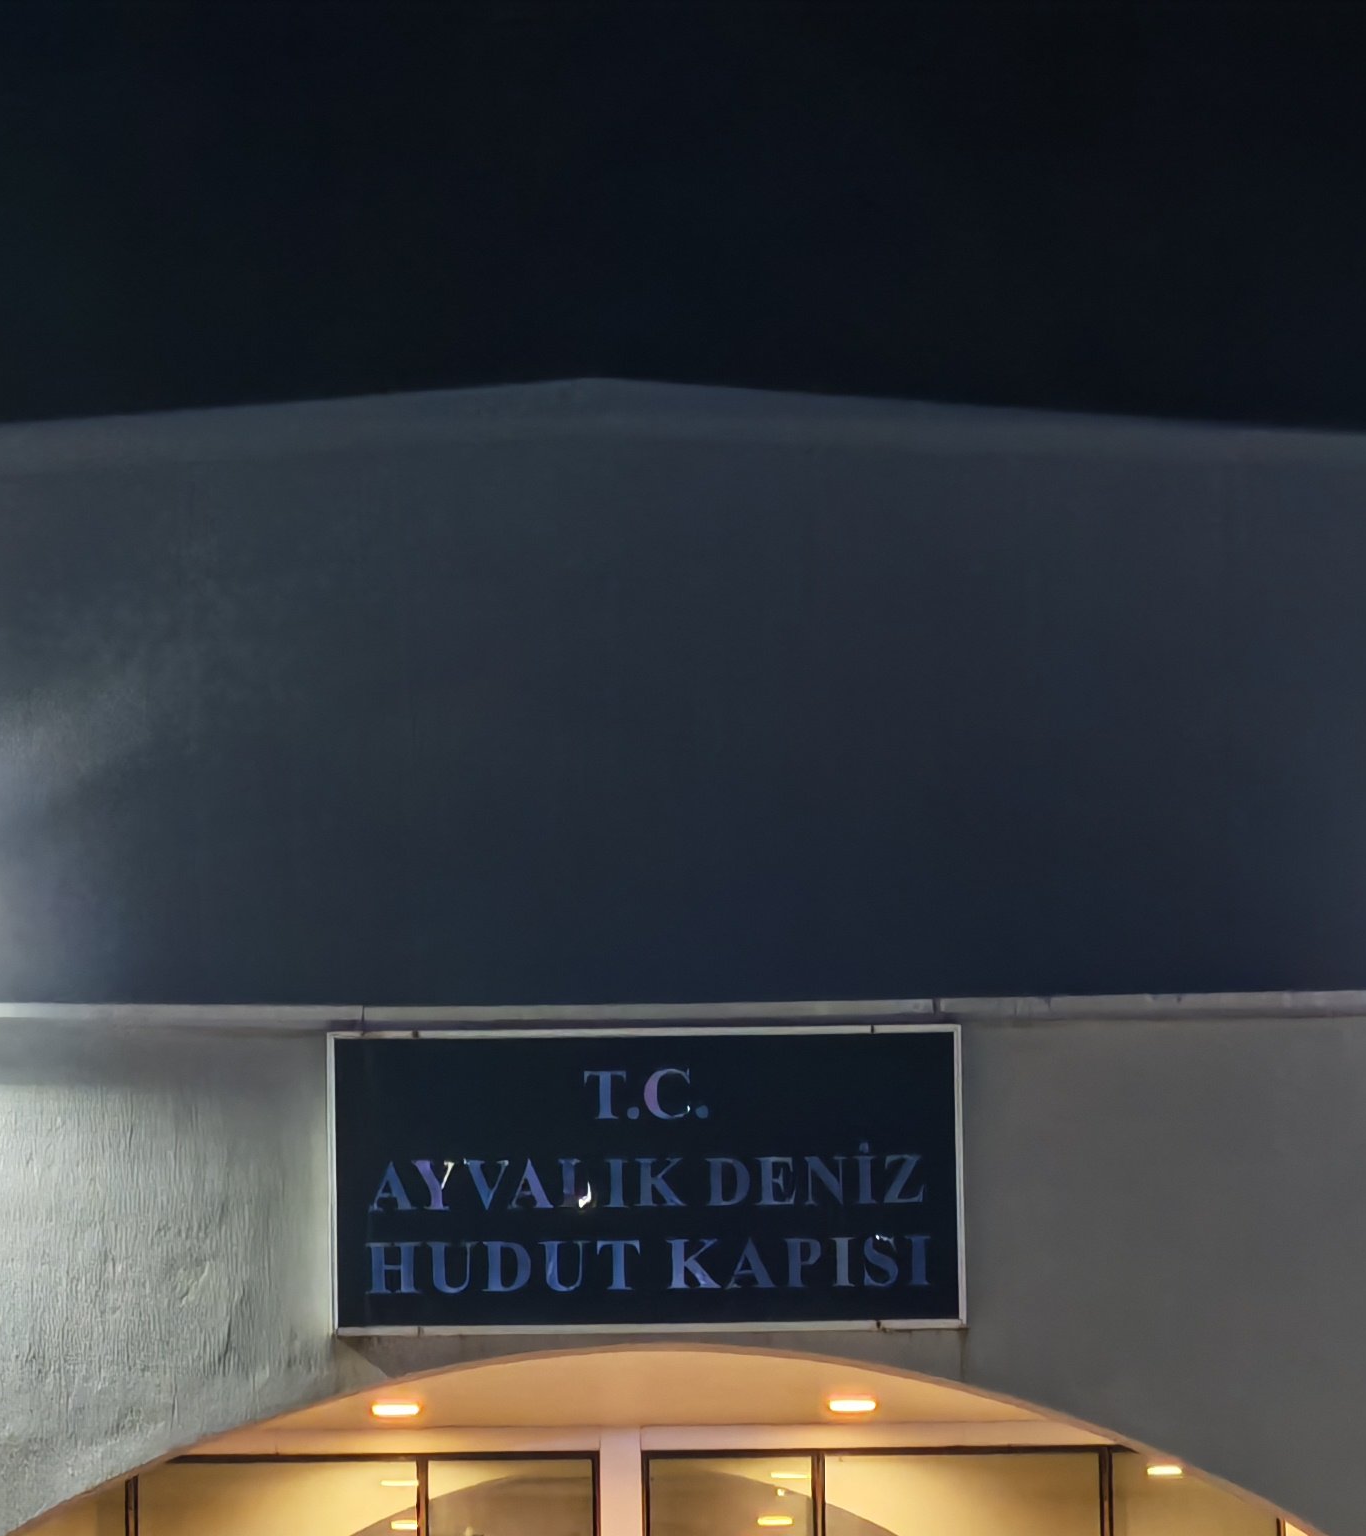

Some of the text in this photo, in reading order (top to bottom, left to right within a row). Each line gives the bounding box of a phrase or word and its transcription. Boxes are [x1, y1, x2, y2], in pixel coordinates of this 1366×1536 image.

[583, 1067, 709, 1121] T.C.
[367, 1142, 928, 1213] AYVALIK DENİZ
[366, 1233, 933, 1295] HUDUT KAPISI
